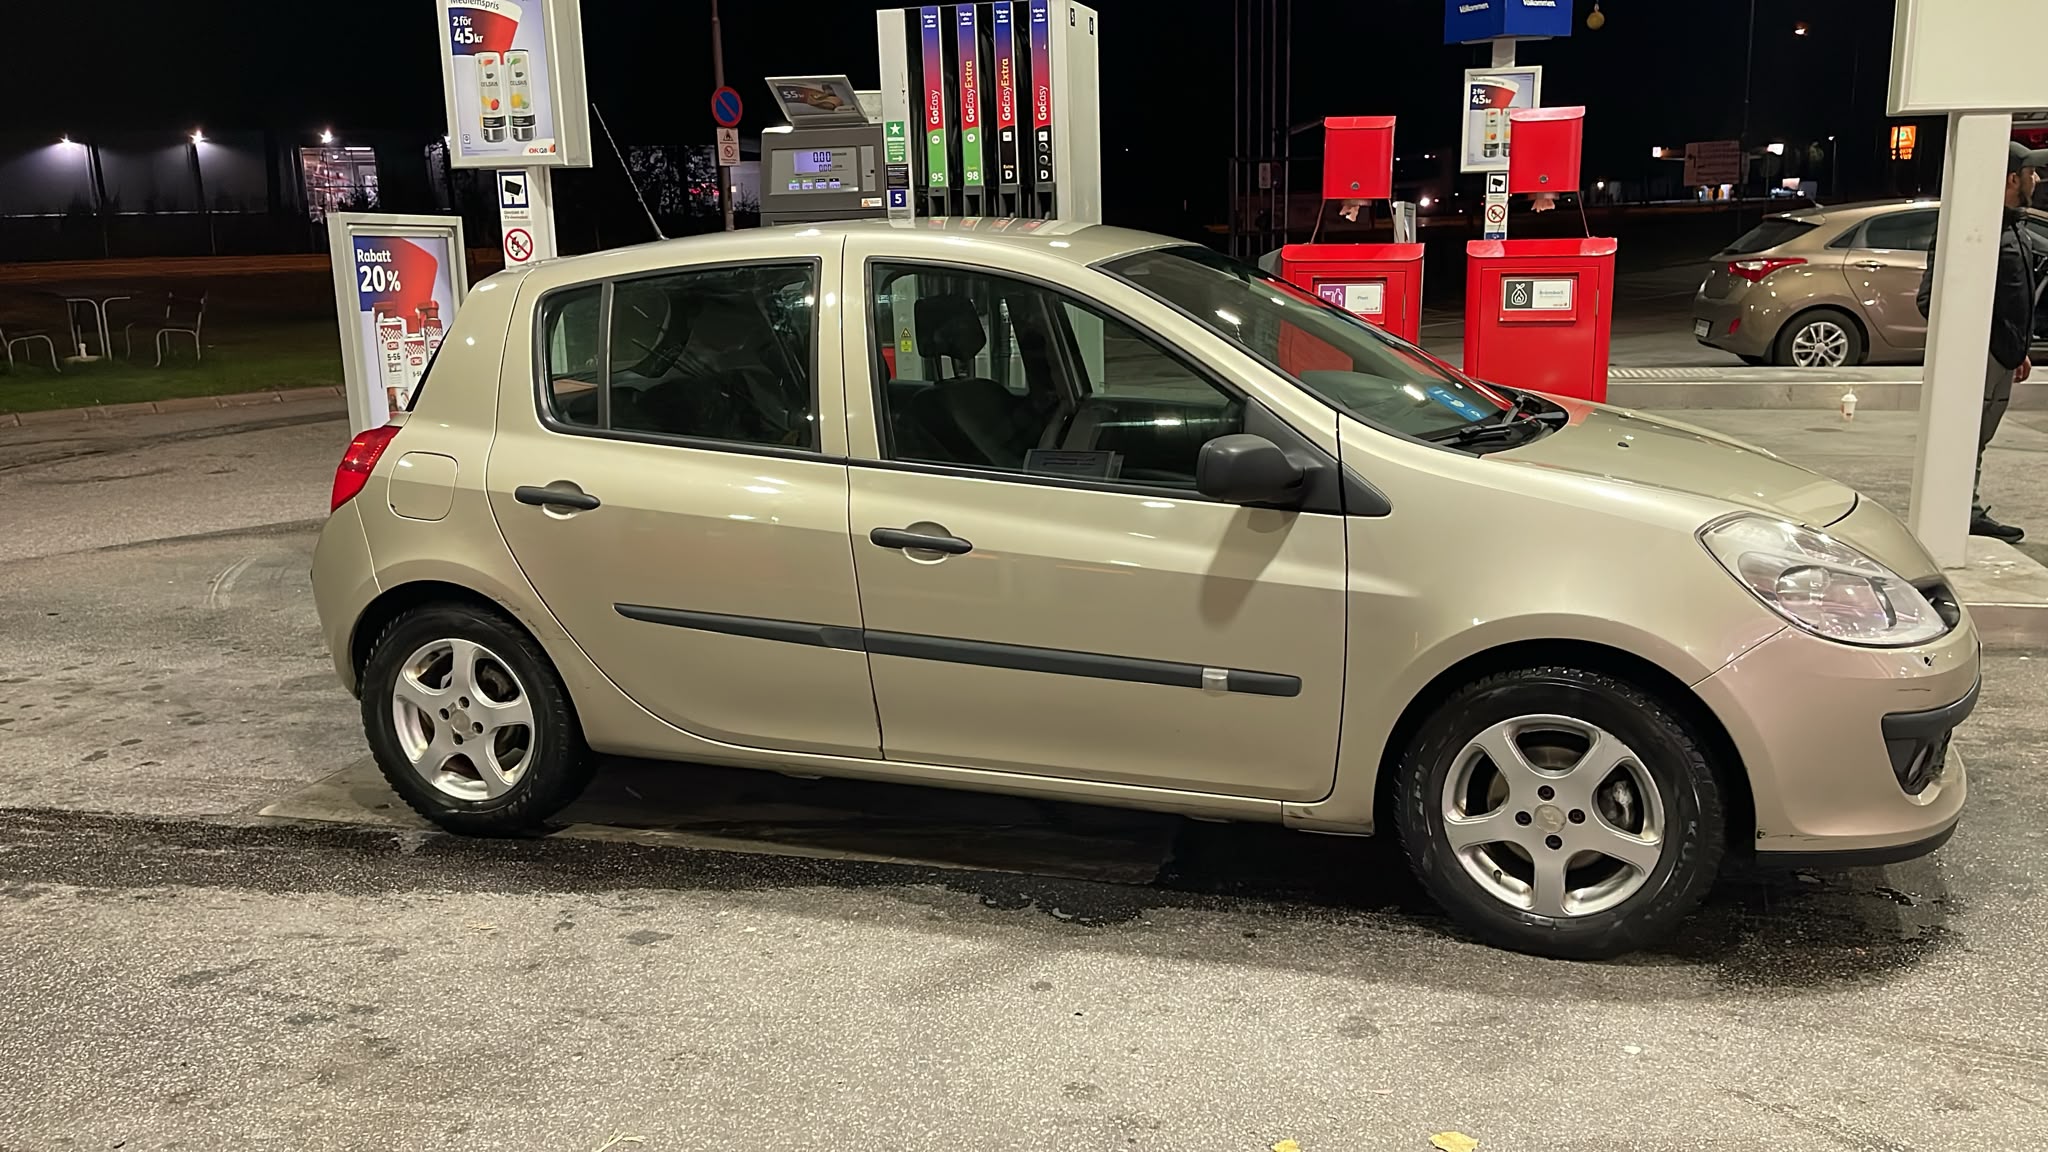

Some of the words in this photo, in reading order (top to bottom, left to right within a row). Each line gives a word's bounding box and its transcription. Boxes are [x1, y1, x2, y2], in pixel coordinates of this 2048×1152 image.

[453, 17, 459, 27] 2
[459, 16, 472, 26] för
[930, 89, 940, 125] GoEasy
[1038, 85, 1048, 121] GoEasy
[931, 172, 944, 182] 95
[966, 171, 979, 181] 98
[1005, 170, 1013, 180] D
[1040, 170, 1049, 180] D
[894, 193, 903, 204] 5
[356, 248, 392, 263] Rabatt
[359, 265, 402, 293] 20%
